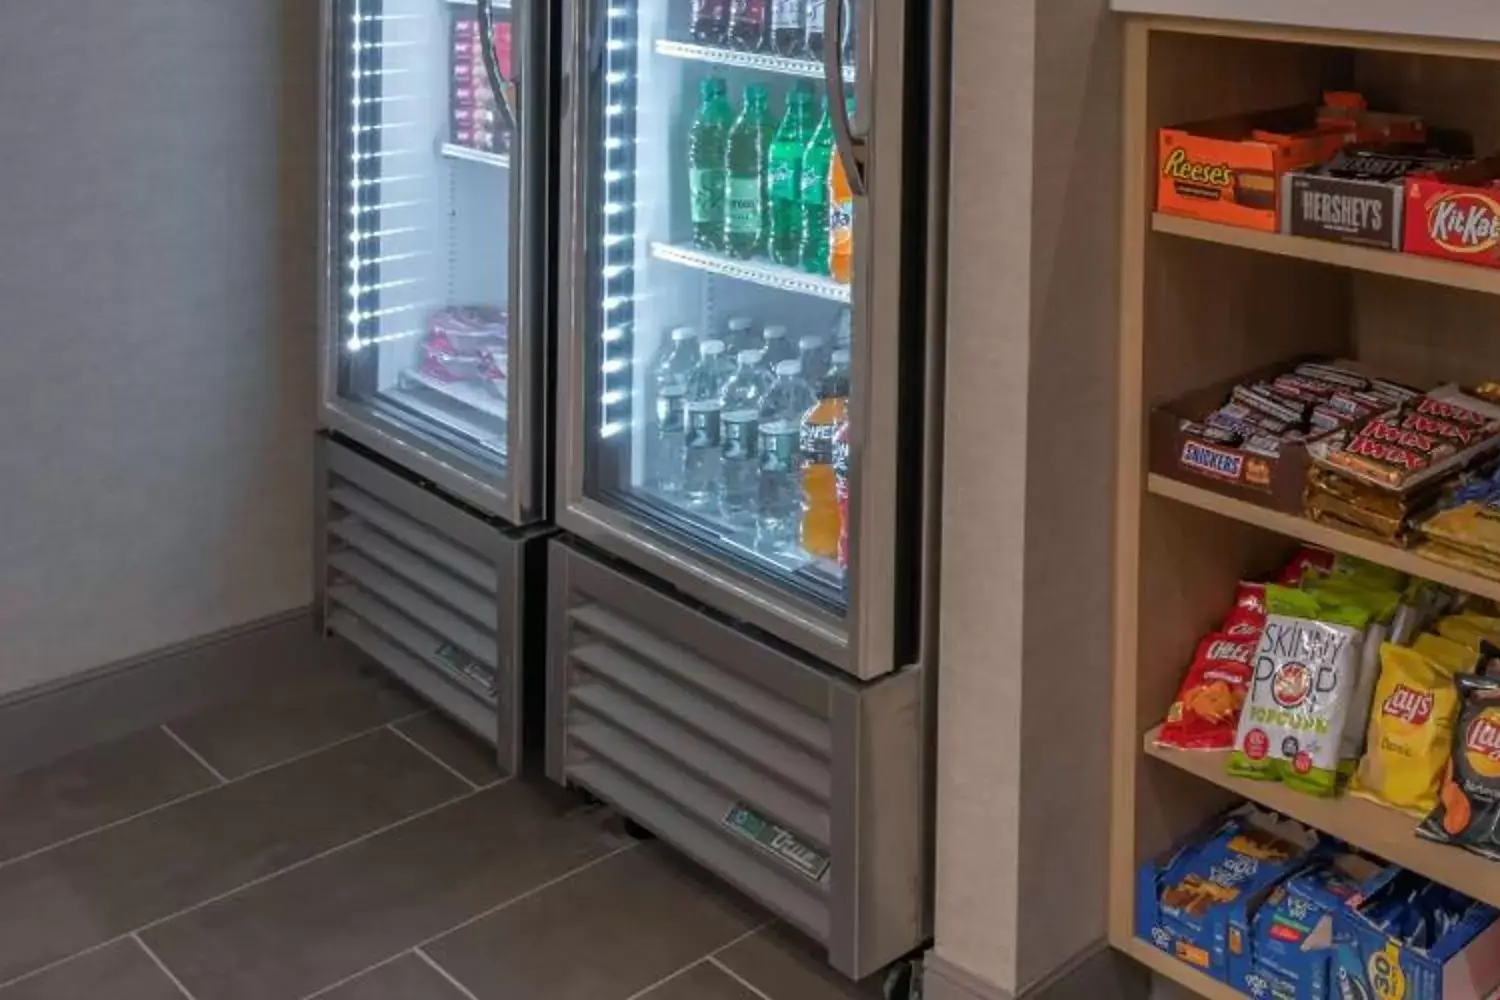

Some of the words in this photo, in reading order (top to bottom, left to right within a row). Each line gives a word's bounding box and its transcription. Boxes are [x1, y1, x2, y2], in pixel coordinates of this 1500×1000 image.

[1164, 150, 1231, 186] Reese's
[1303, 191, 1383, 231] HERSHEY'S
[1182, 444, 1242, 477] SNICKERS
[1262, 621, 1347, 665] SKINNY
[1251, 656, 1338, 713] POP
[1384, 687, 1433, 722] Lay's
